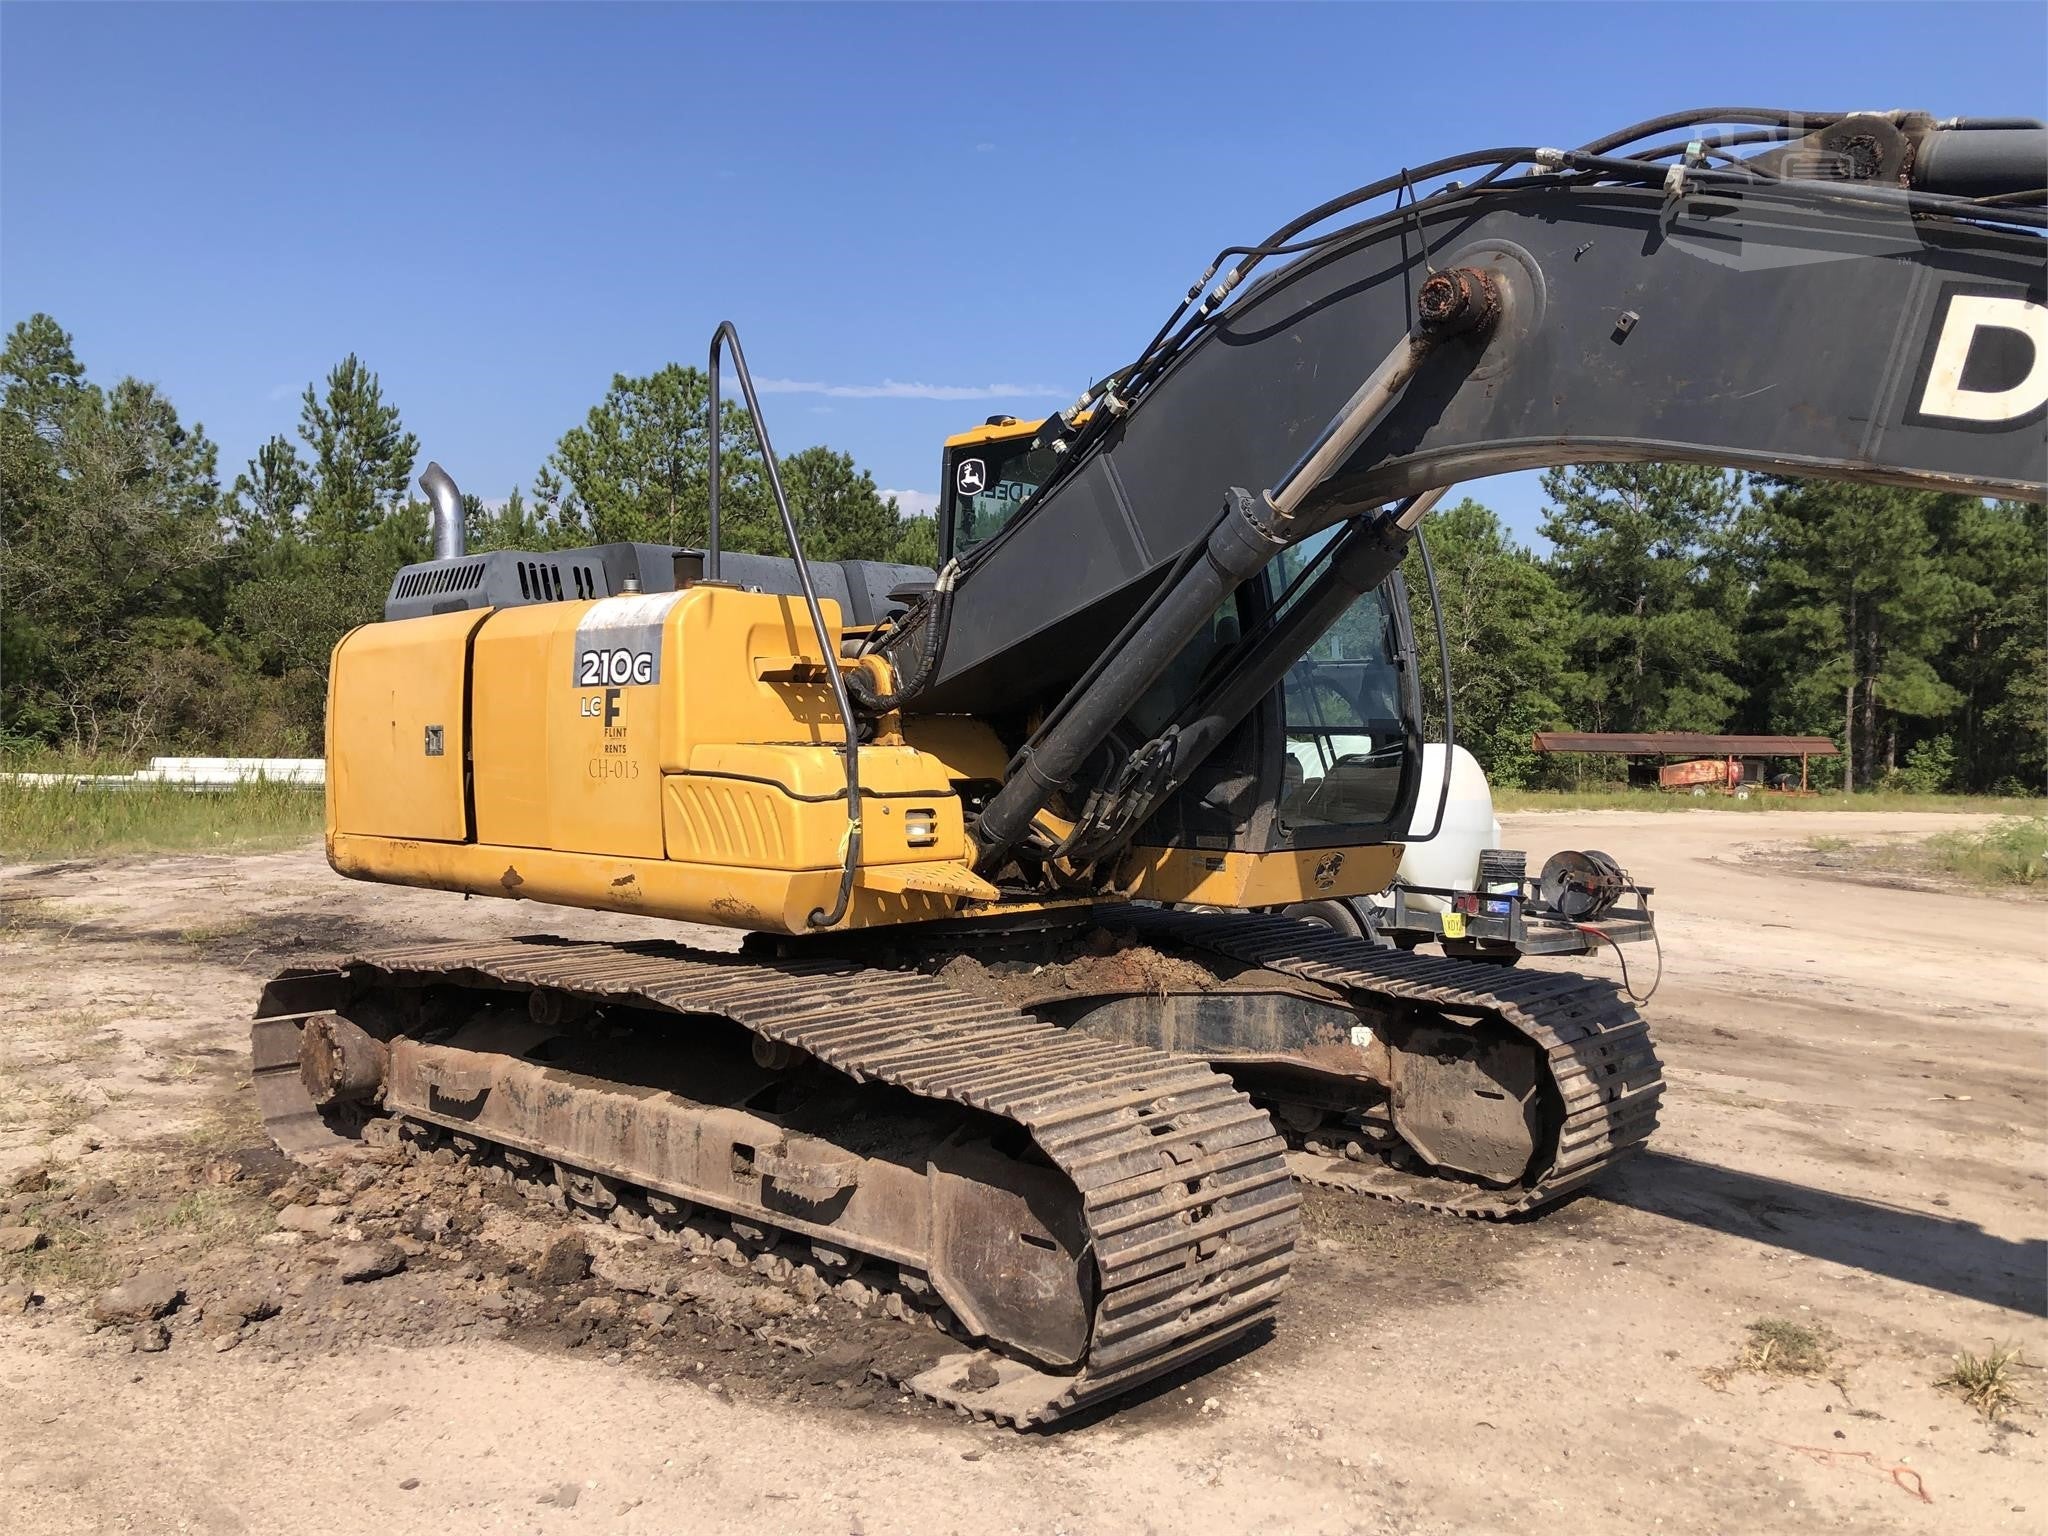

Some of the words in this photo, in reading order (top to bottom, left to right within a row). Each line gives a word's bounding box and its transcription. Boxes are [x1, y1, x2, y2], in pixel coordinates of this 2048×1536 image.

[581, 648, 652, 687] 210G
[581, 697, 602, 717] LC
[604, 728, 627, 738] FLINT
[604, 744, 627, 754] RENTS
[589, 758, 639, 779] CH-013
